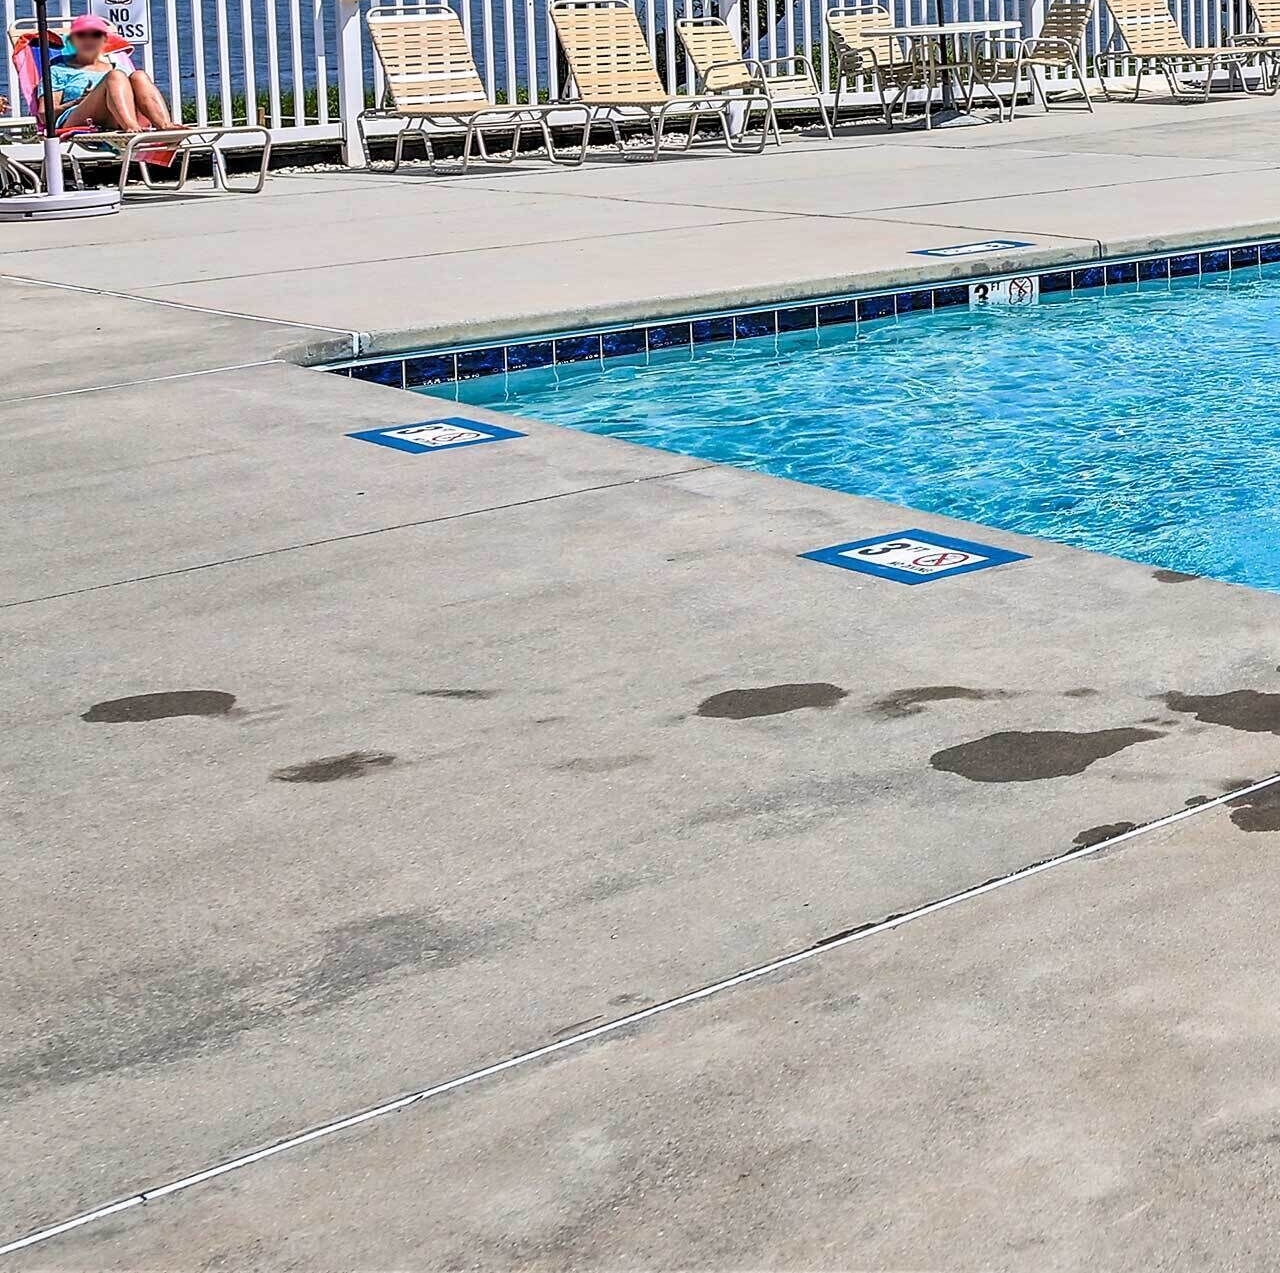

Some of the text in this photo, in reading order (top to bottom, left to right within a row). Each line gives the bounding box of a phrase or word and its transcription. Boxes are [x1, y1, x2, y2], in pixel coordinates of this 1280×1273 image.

[109, 8, 130, 23] NO
[117, 24, 144, 38] ASS
[858, 543, 911, 555] 3
